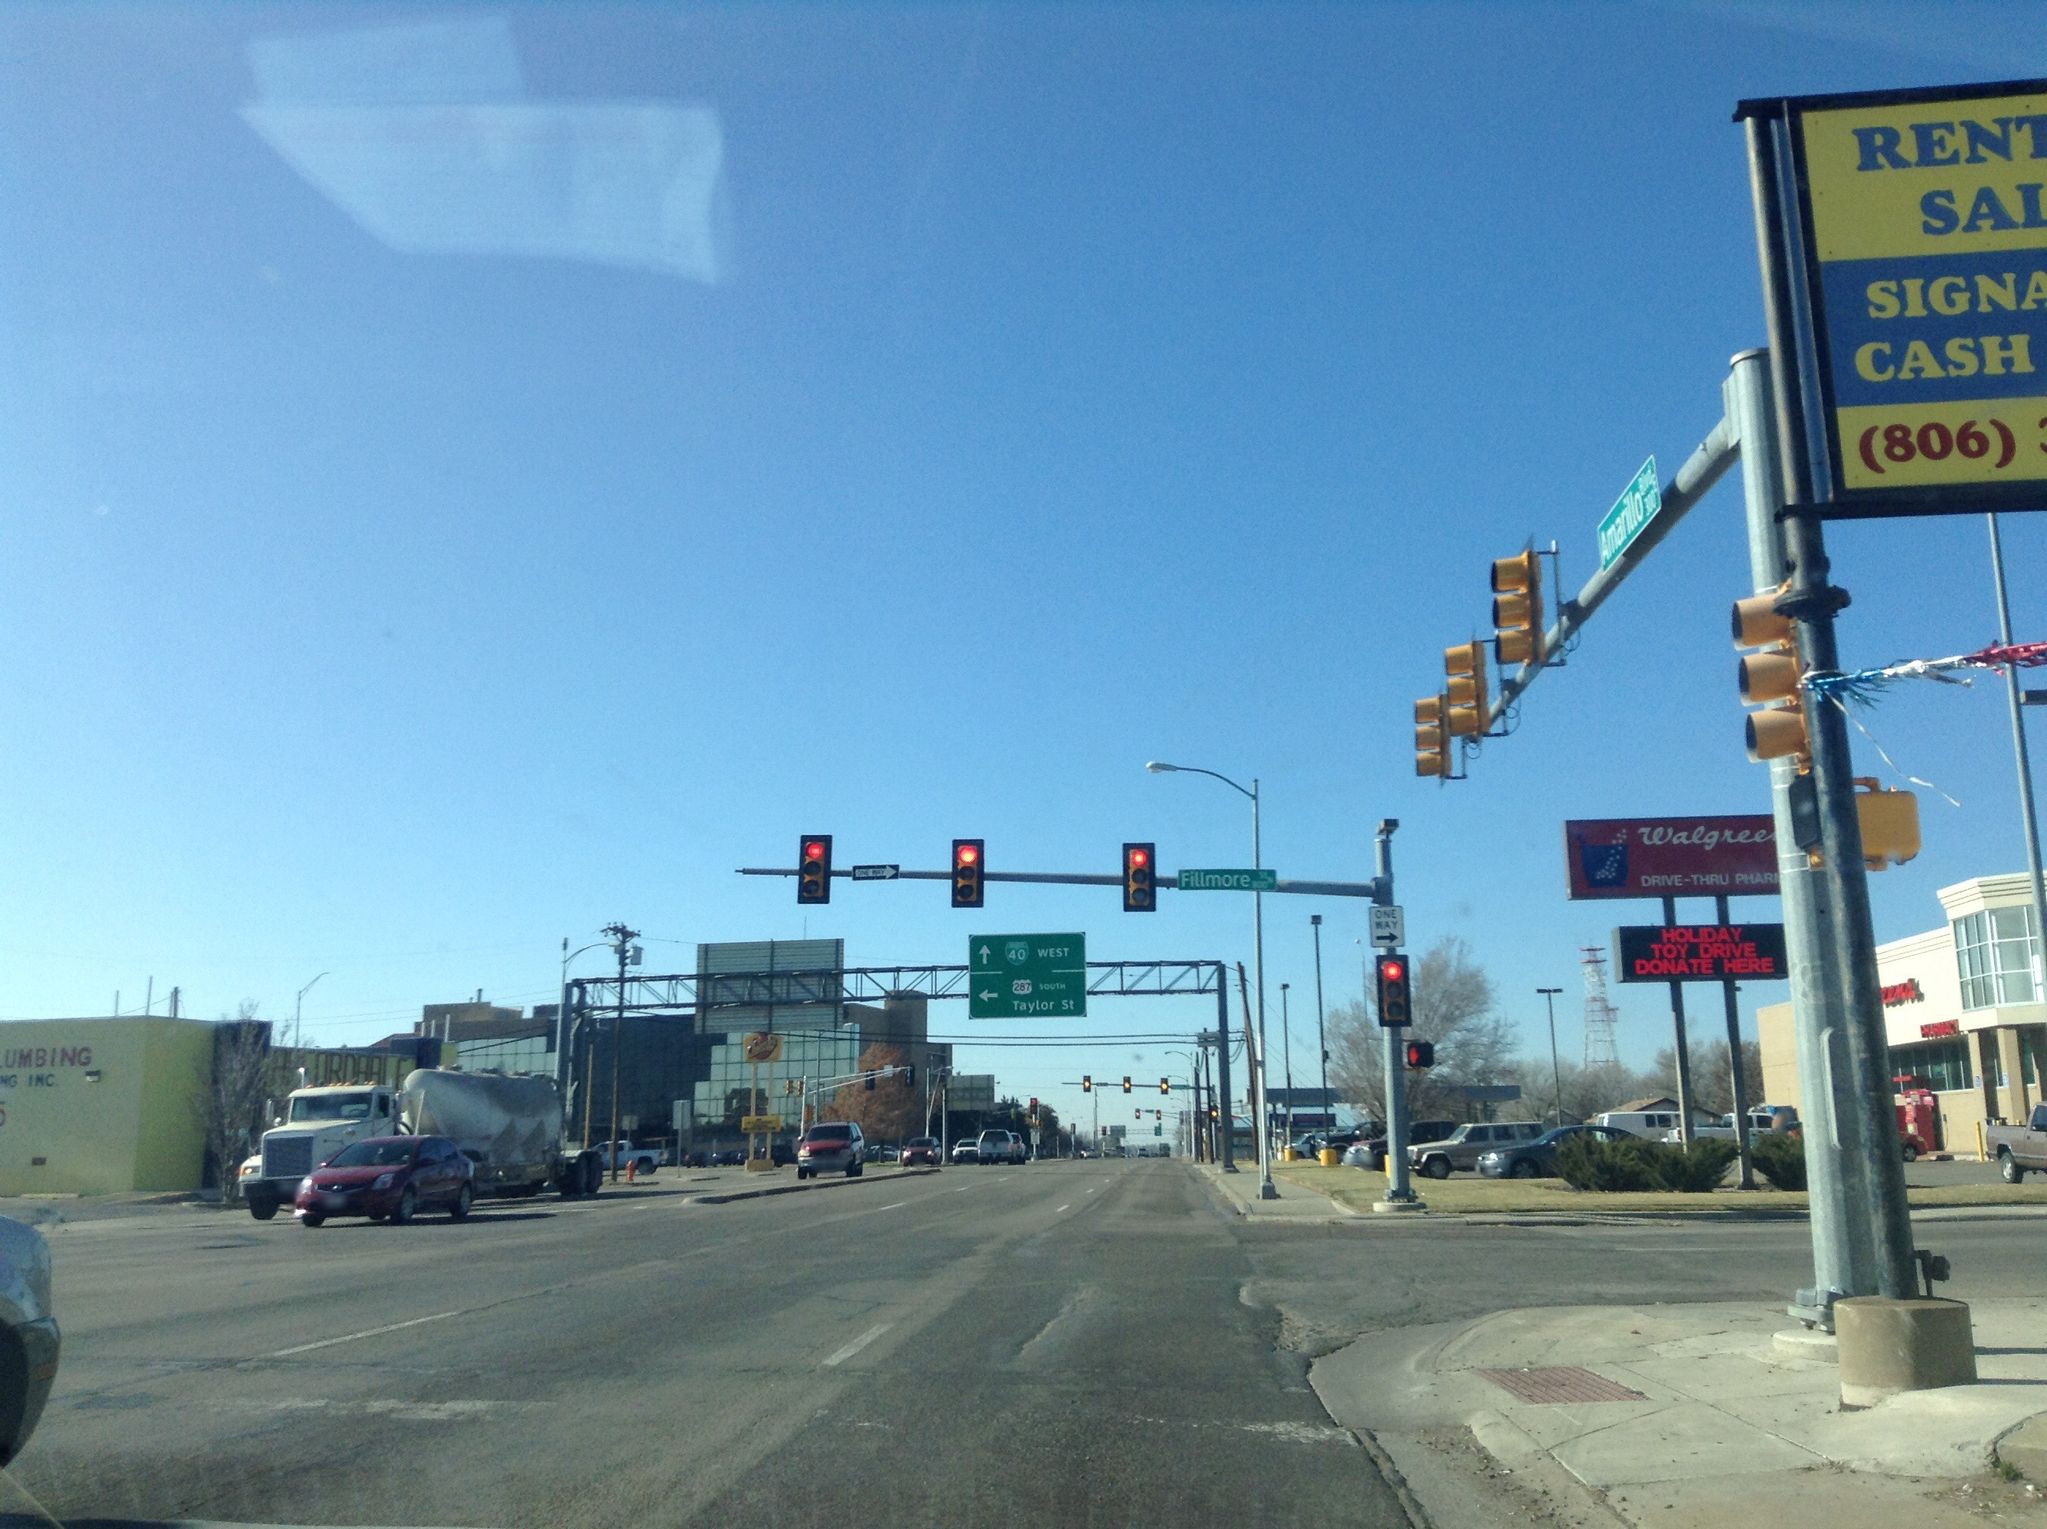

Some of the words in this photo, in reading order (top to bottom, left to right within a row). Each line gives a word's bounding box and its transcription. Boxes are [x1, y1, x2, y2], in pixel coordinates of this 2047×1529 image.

[1854, 334, 2035, 382] CASH
[1858, 418, 2016, 475] (806)
[1600, 491, 1644, 567] Amarillo
[1637, 825, 1777, 851] Walgree
[1181, 871, 1251, 887] Fillmore
[1641, 873, 1729, 887] DRIVE-THRU
[1375, 909, 1397, 919] ONE
[1375, 921, 1398, 930] WAY
[1661, 927, 1742, 943] HOLIDAY
[1009, 949, 1026, 961] 40
[1037, 948, 1069, 958] WEST
[1650, 944, 1687, 960] TOY
[1699, 943, 1756, 959] DRIVE
[1634, 959, 1713, 975] DONATE
[1724, 958, 1776, 974] HERE
[1014, 982, 1031, 992] 287
[1039, 983, 1066, 991] SOUTH
[1012, 1000, 1055, 1013] Taylor
[1061, 999, 1075, 1010] St
